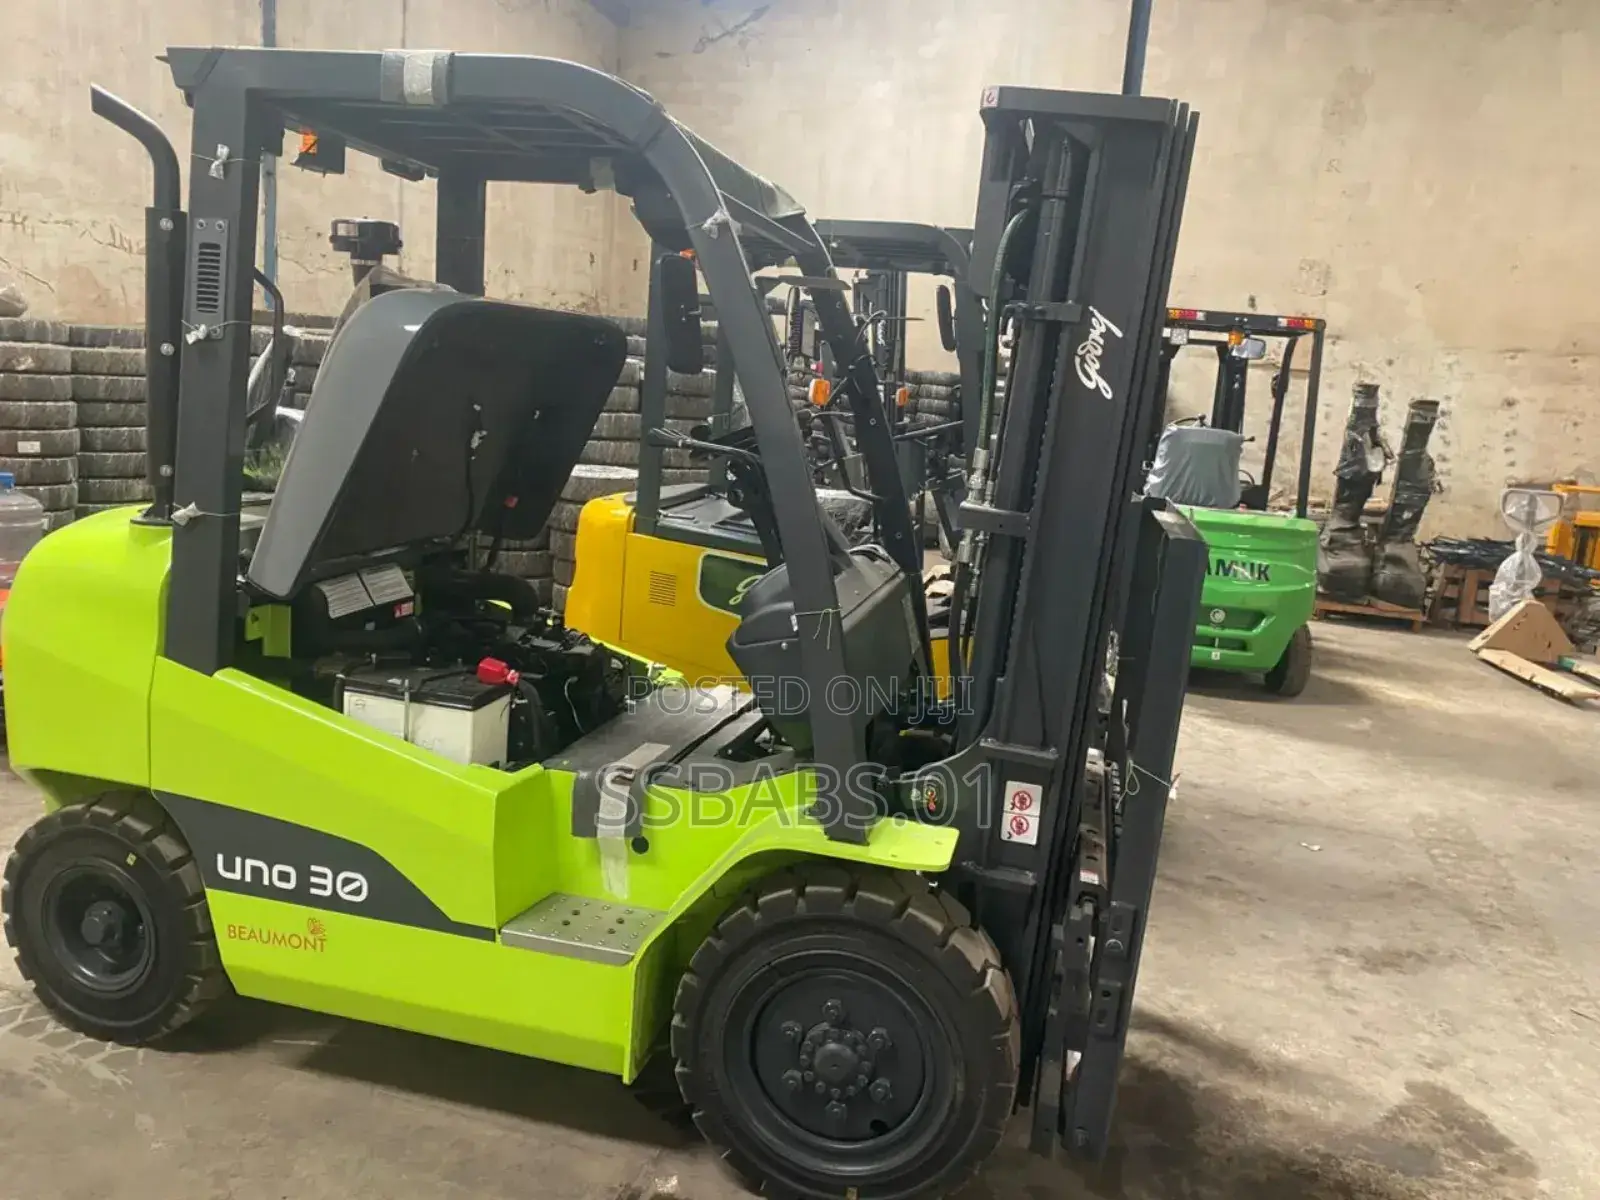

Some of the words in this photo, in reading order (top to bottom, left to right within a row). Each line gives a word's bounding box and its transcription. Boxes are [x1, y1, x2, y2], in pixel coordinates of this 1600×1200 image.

[1075, 306, 1123, 399] Godrej
[309, 864, 368, 902] 30
[227, 924, 327, 952] BEAUMONT
